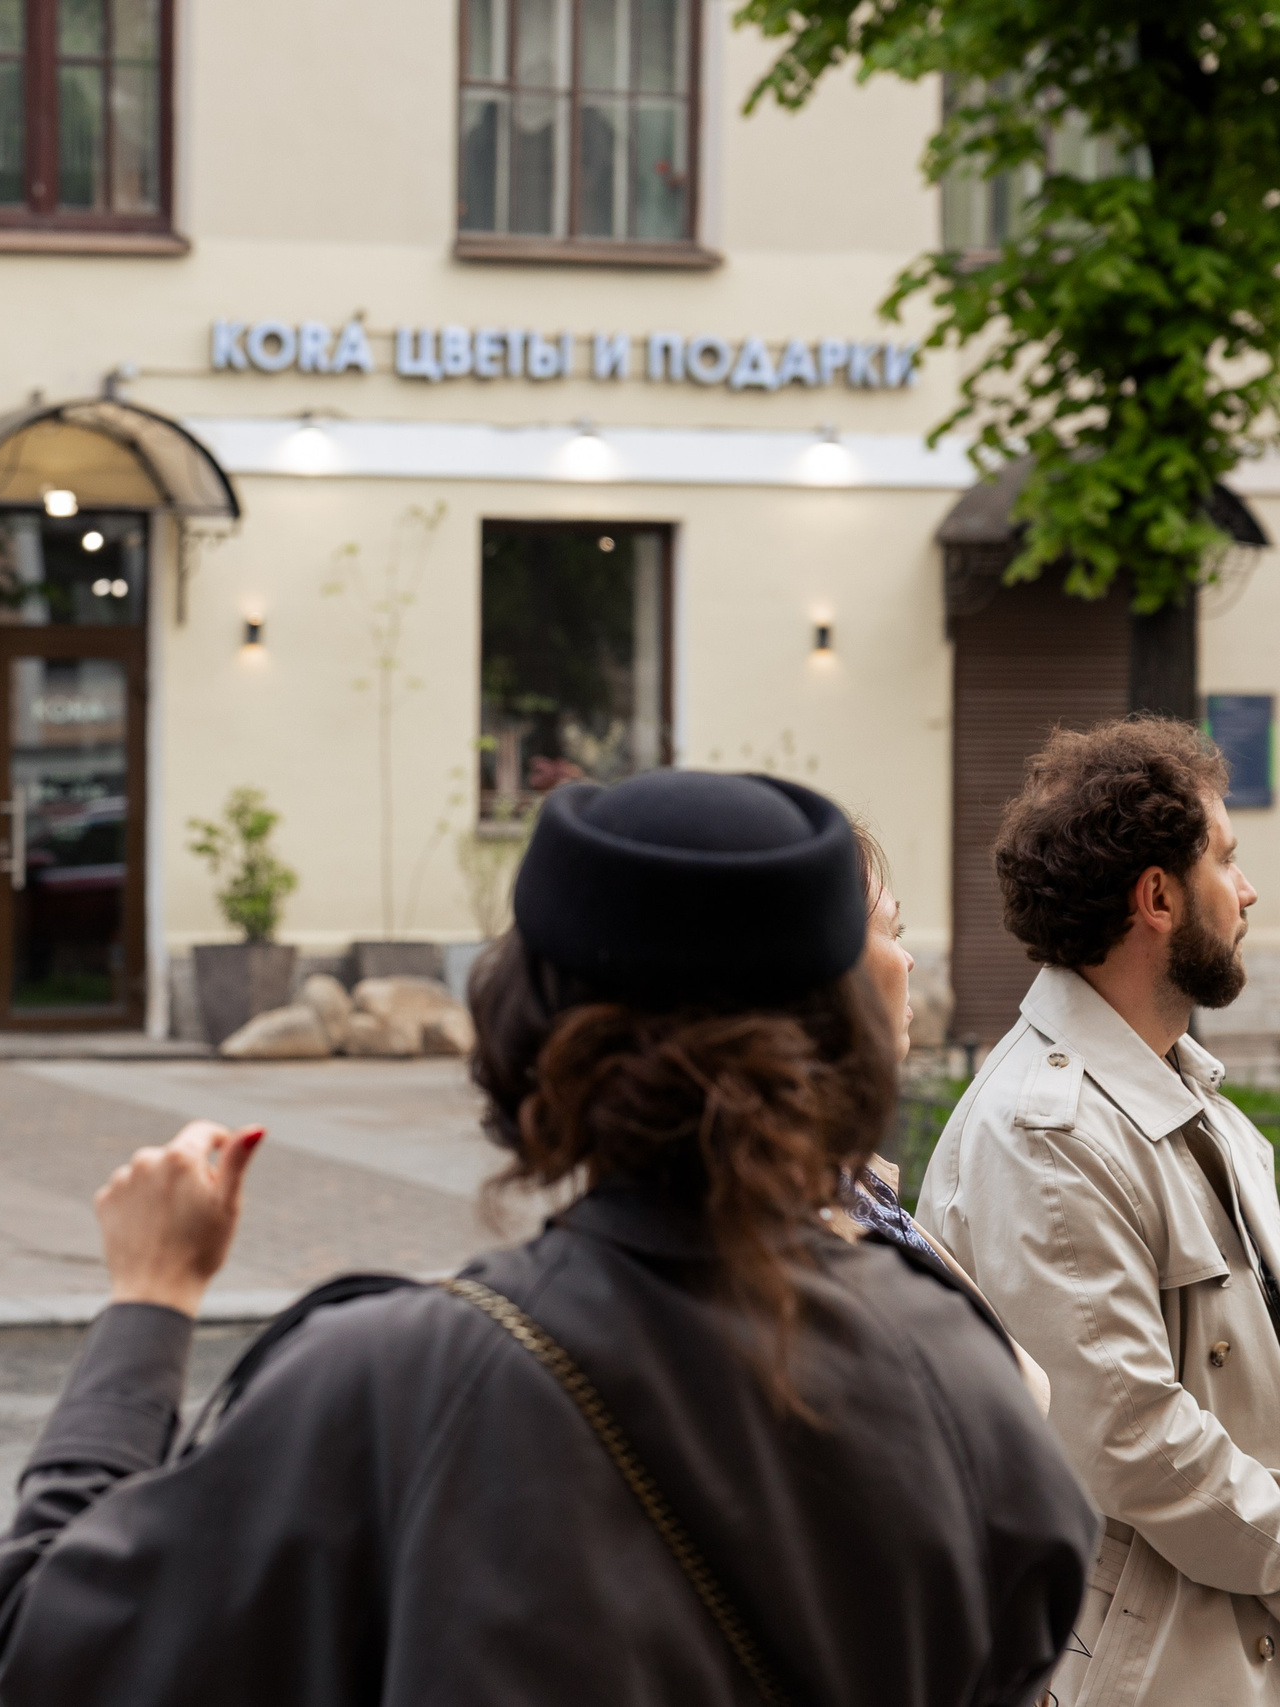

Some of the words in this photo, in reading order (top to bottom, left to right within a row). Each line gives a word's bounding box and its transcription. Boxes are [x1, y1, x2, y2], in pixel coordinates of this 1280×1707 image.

[394, 325, 574, 385] ЦВЕТЫ
[592, 333, 631, 383] И
[648, 333, 922, 392] ПОДАРКИ
